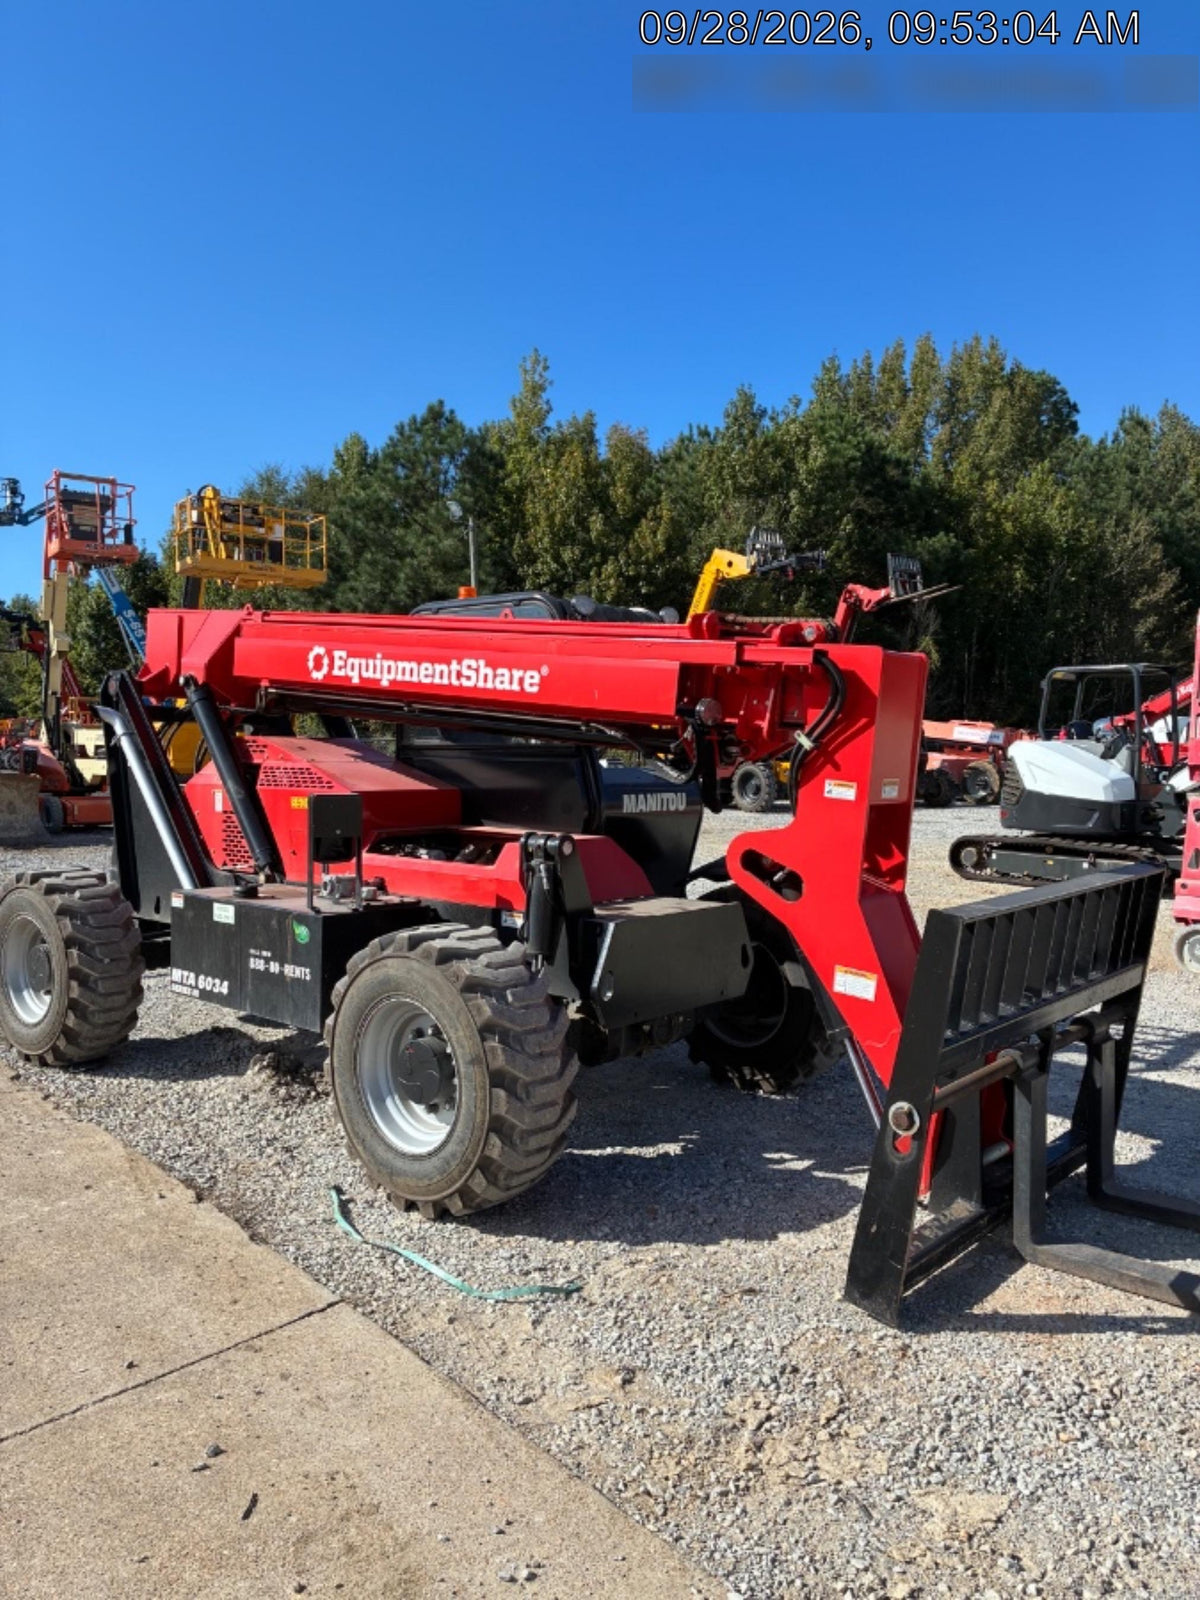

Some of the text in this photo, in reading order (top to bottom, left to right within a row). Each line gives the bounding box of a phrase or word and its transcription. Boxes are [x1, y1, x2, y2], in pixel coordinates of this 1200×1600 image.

[623, 792, 687, 814] MANITOU
[171, 968, 196, 987] MTA
[198, 974, 229, 995] 6034
